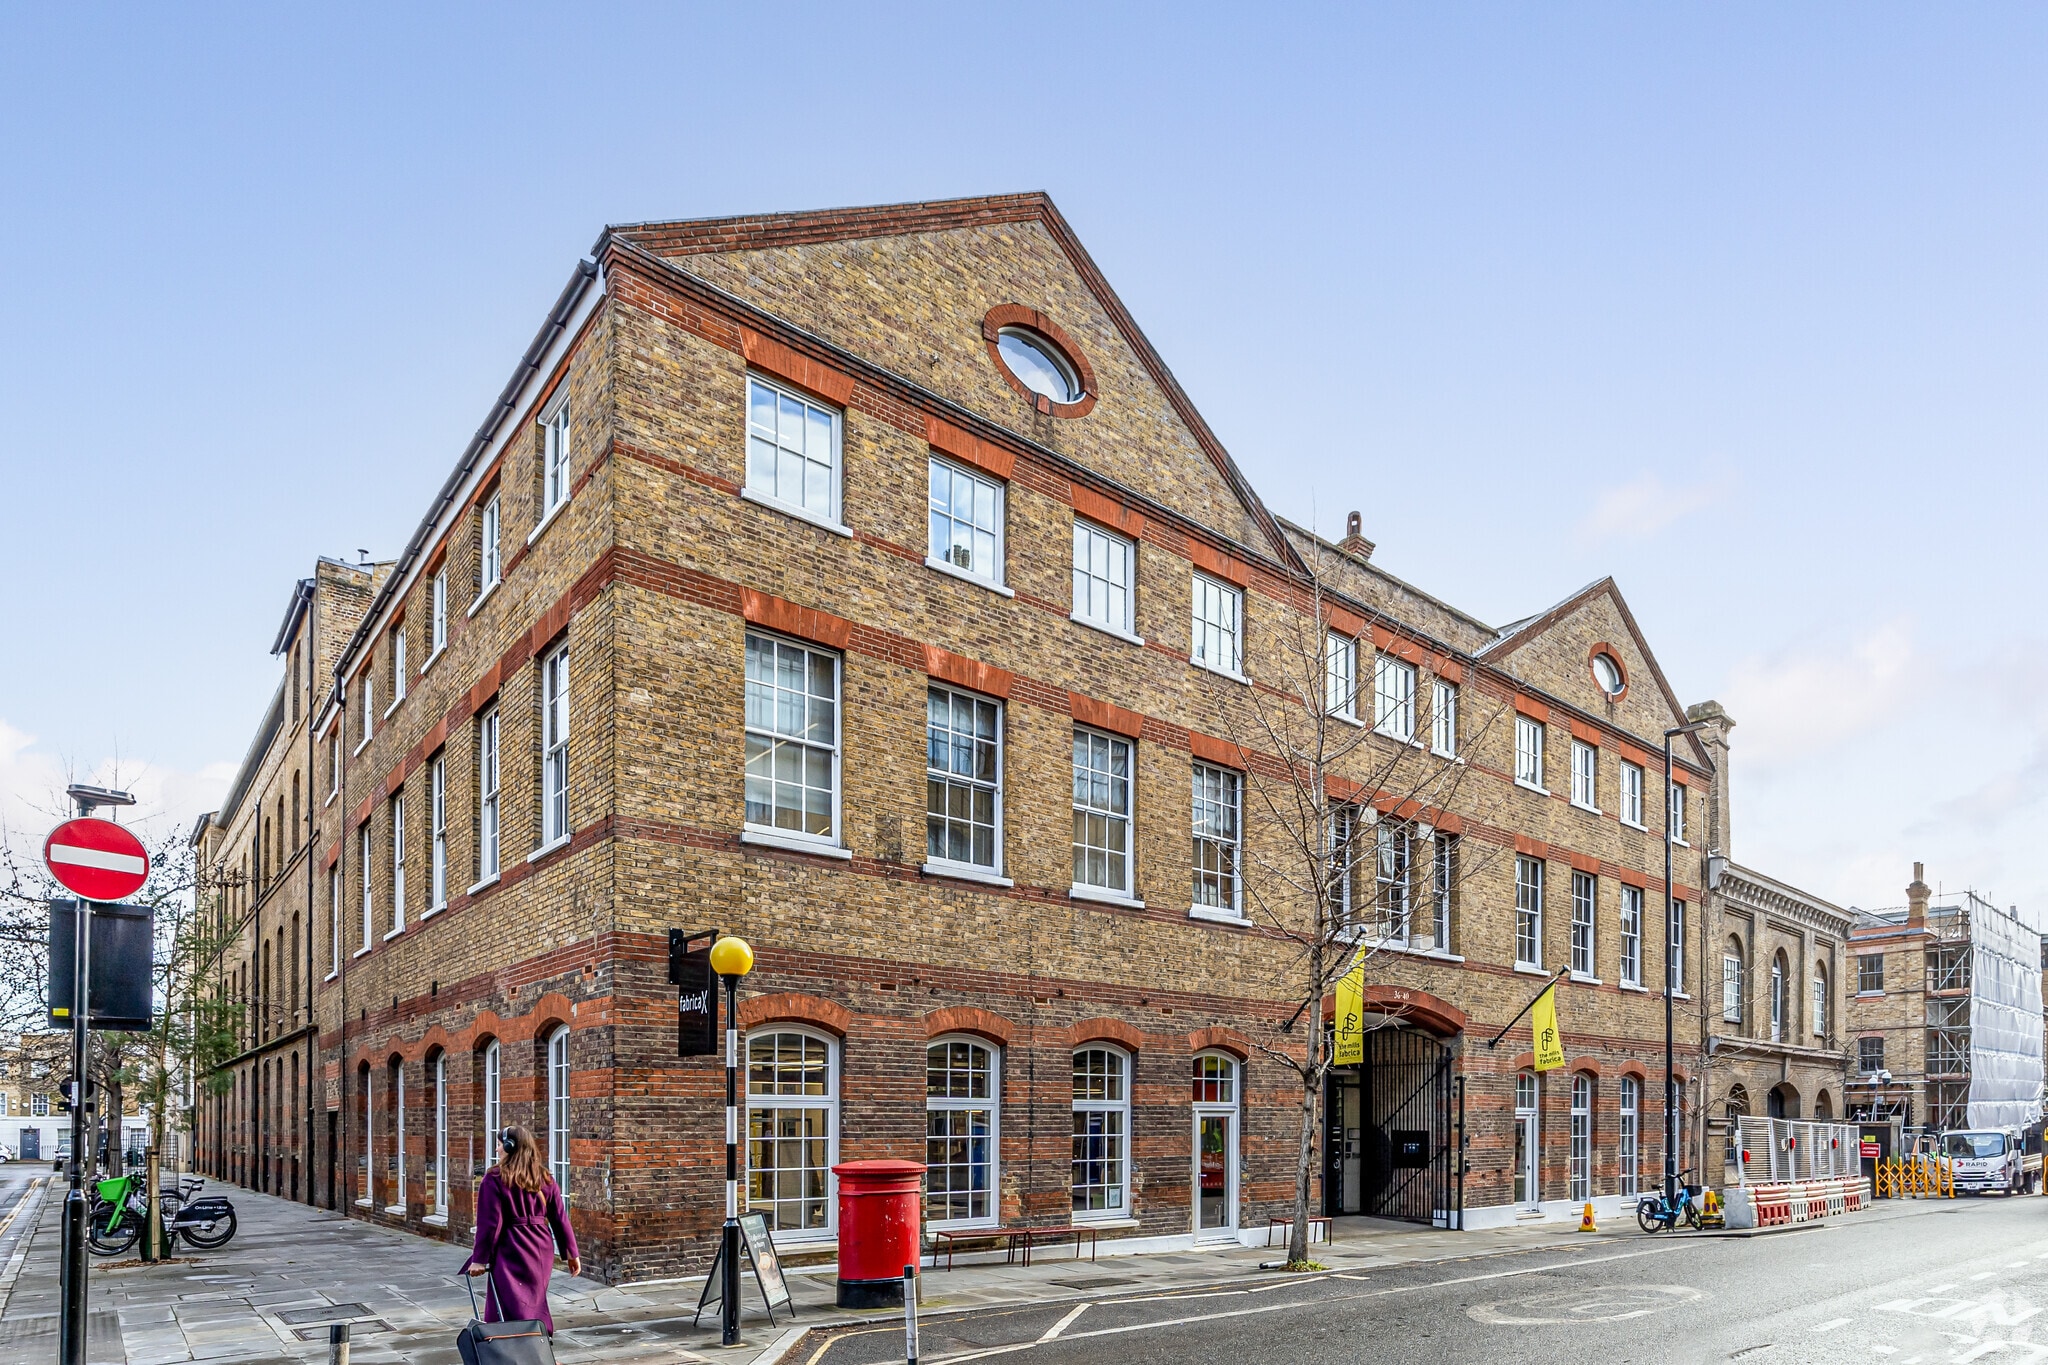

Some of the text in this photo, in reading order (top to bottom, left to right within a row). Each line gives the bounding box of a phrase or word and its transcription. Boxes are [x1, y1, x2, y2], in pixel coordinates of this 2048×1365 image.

[1393, 990, 1410, 1000] 36-40
[680, 990, 708, 1014] fabricaX
[1339, 1049, 1360, 1058] fabrica
[1539, 1056, 1561, 1065] fabrica
